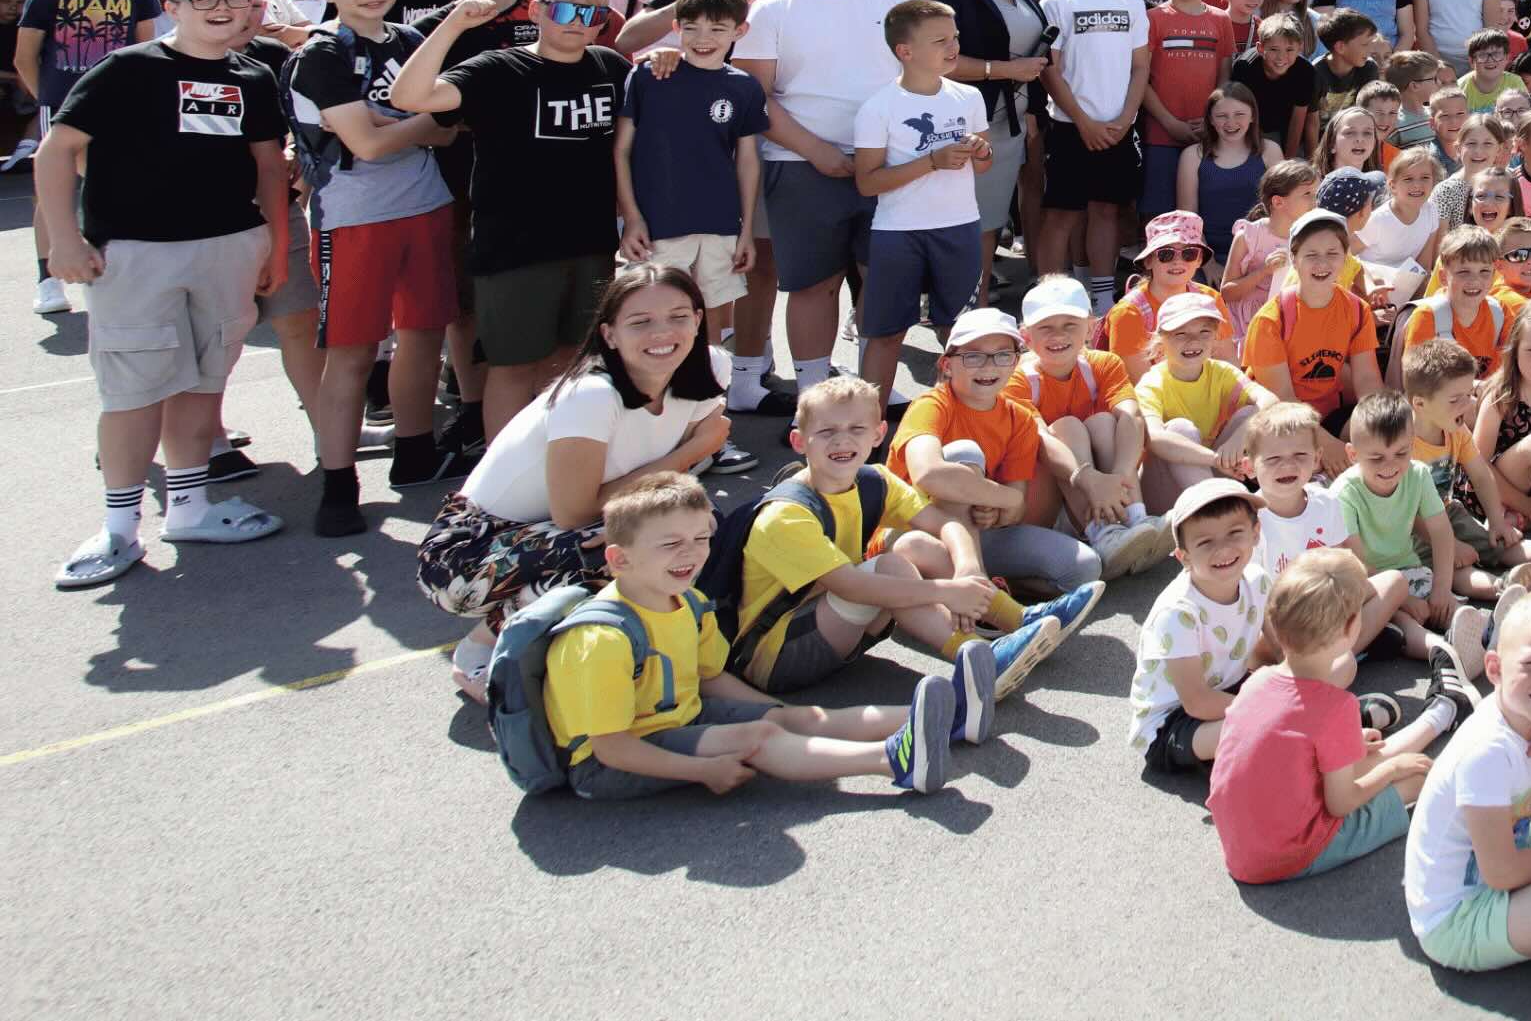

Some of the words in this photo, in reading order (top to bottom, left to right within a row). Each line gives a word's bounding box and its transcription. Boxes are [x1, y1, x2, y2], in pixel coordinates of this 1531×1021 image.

[1076, 12, 1128, 26] adidas
[1168, 51, 1215, 59] HILFIGER
[191, 83, 225, 96] NIKE
[186, 101, 238, 115] AIR
[548, 93, 612, 131] THE
